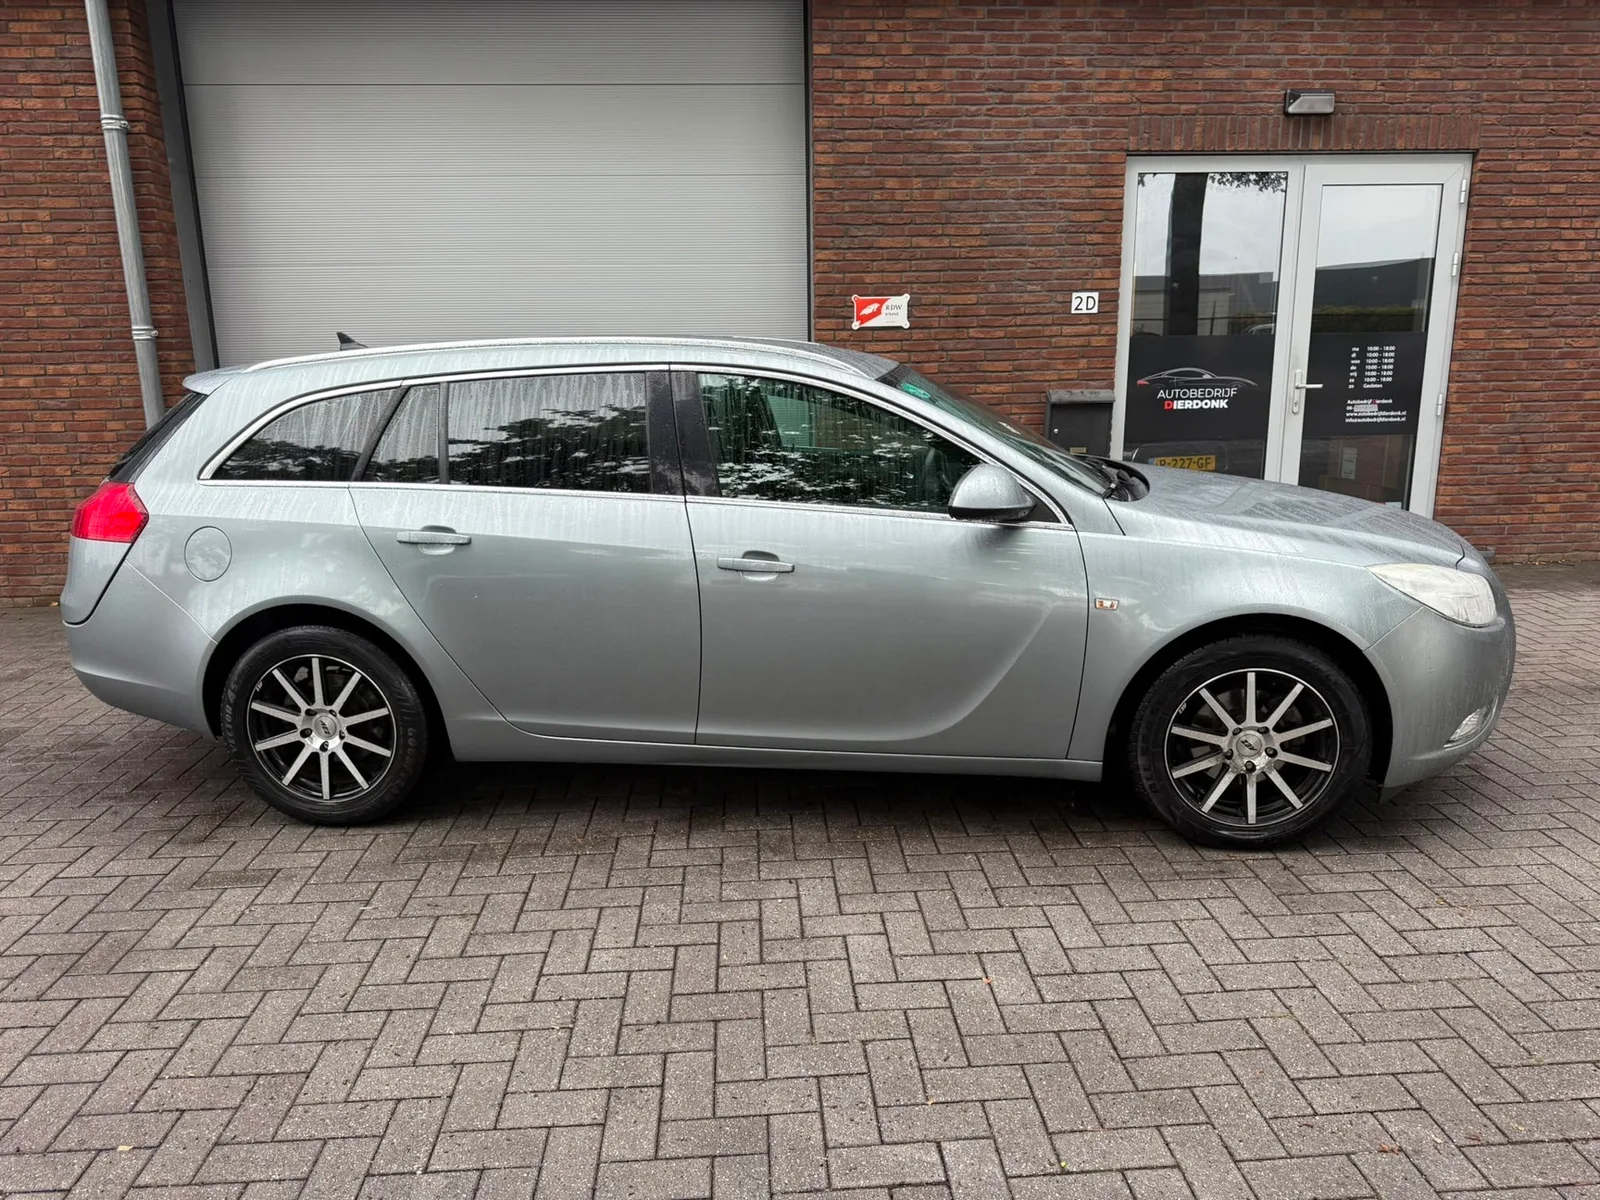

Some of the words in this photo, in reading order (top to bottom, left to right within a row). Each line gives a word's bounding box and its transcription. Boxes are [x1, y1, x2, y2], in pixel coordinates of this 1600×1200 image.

[1074, 296, 1096, 310] 2D
[1157, 388, 1238, 399] AUTOBEDRIJF
[1164, 399, 1228, 410] DIERDONK
